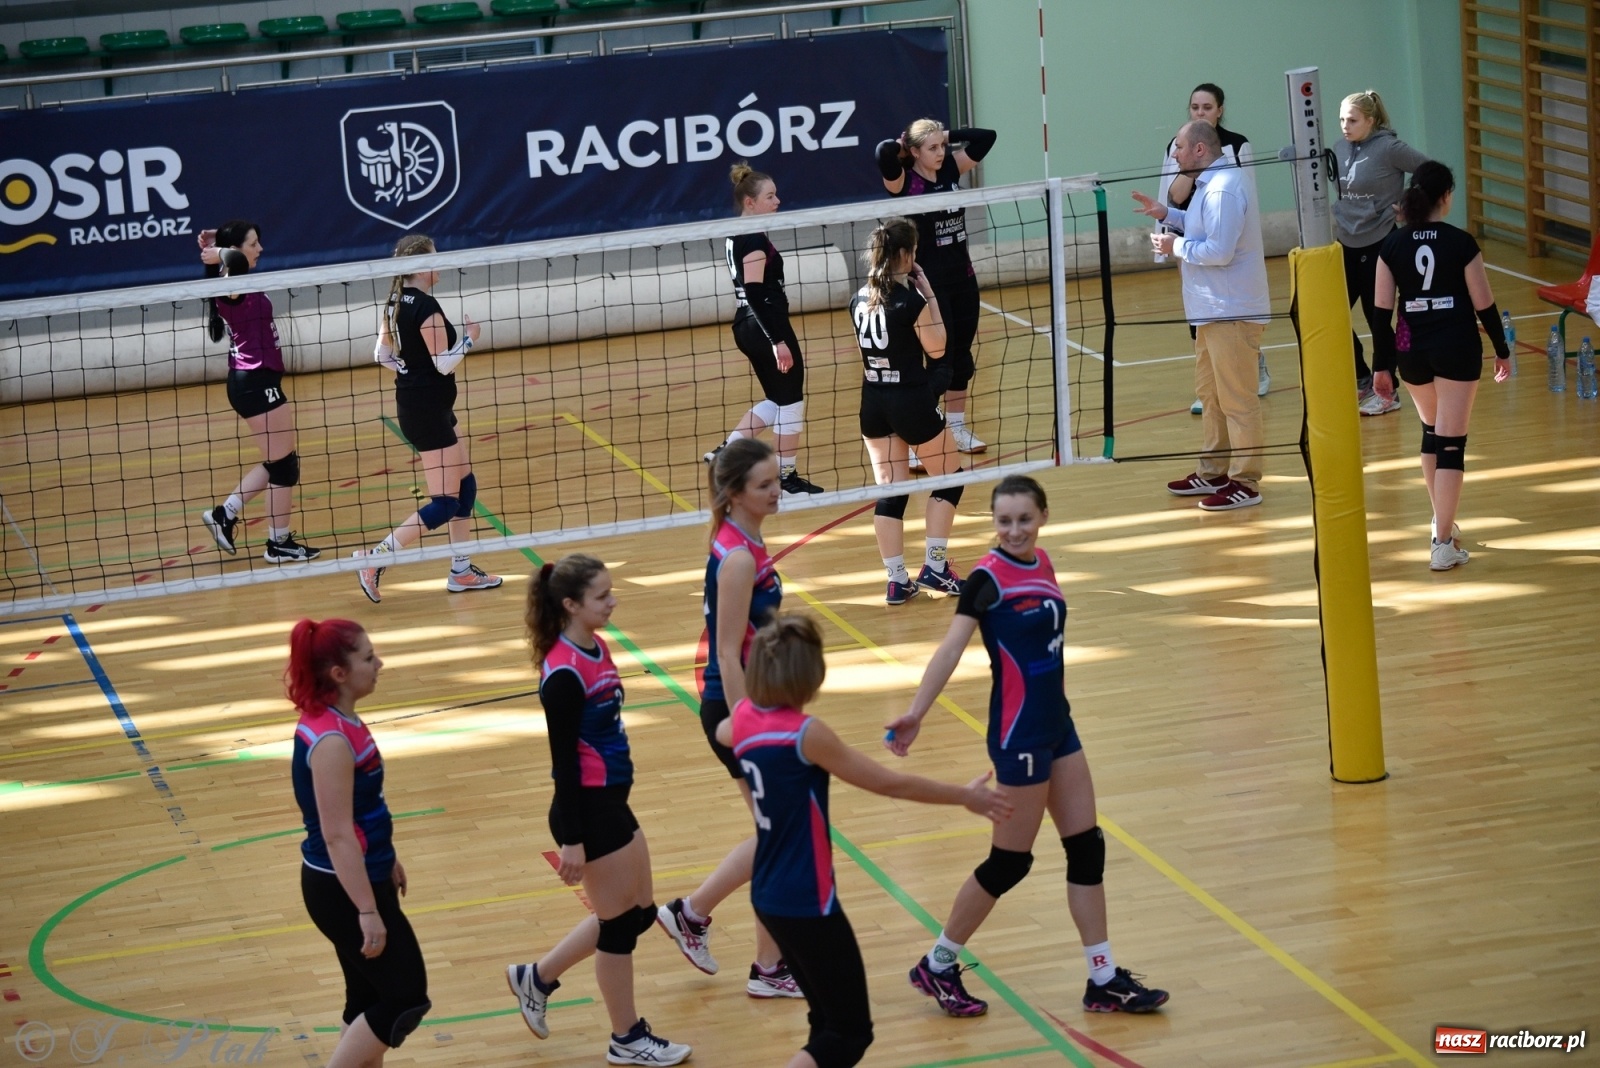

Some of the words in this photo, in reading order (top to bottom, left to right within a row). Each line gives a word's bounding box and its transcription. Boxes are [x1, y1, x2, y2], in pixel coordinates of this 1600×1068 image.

[526, 92, 859, 178] RACIBÓRZ
[70, 214, 193, 246] RACIBÓRZ
[945, 216, 964, 227] VOLLE
[1412, 230, 1438, 240] GUTH
[1415, 244, 1436, 291] 9
[854, 301, 889, 350] 20
[264, 387, 280, 403] 21
[1043, 598, 1059, 631] 7
[1018, 752, 1034, 777] 7
[740, 758, 772, 831] 2
[1092, 954, 1107, 968] R
